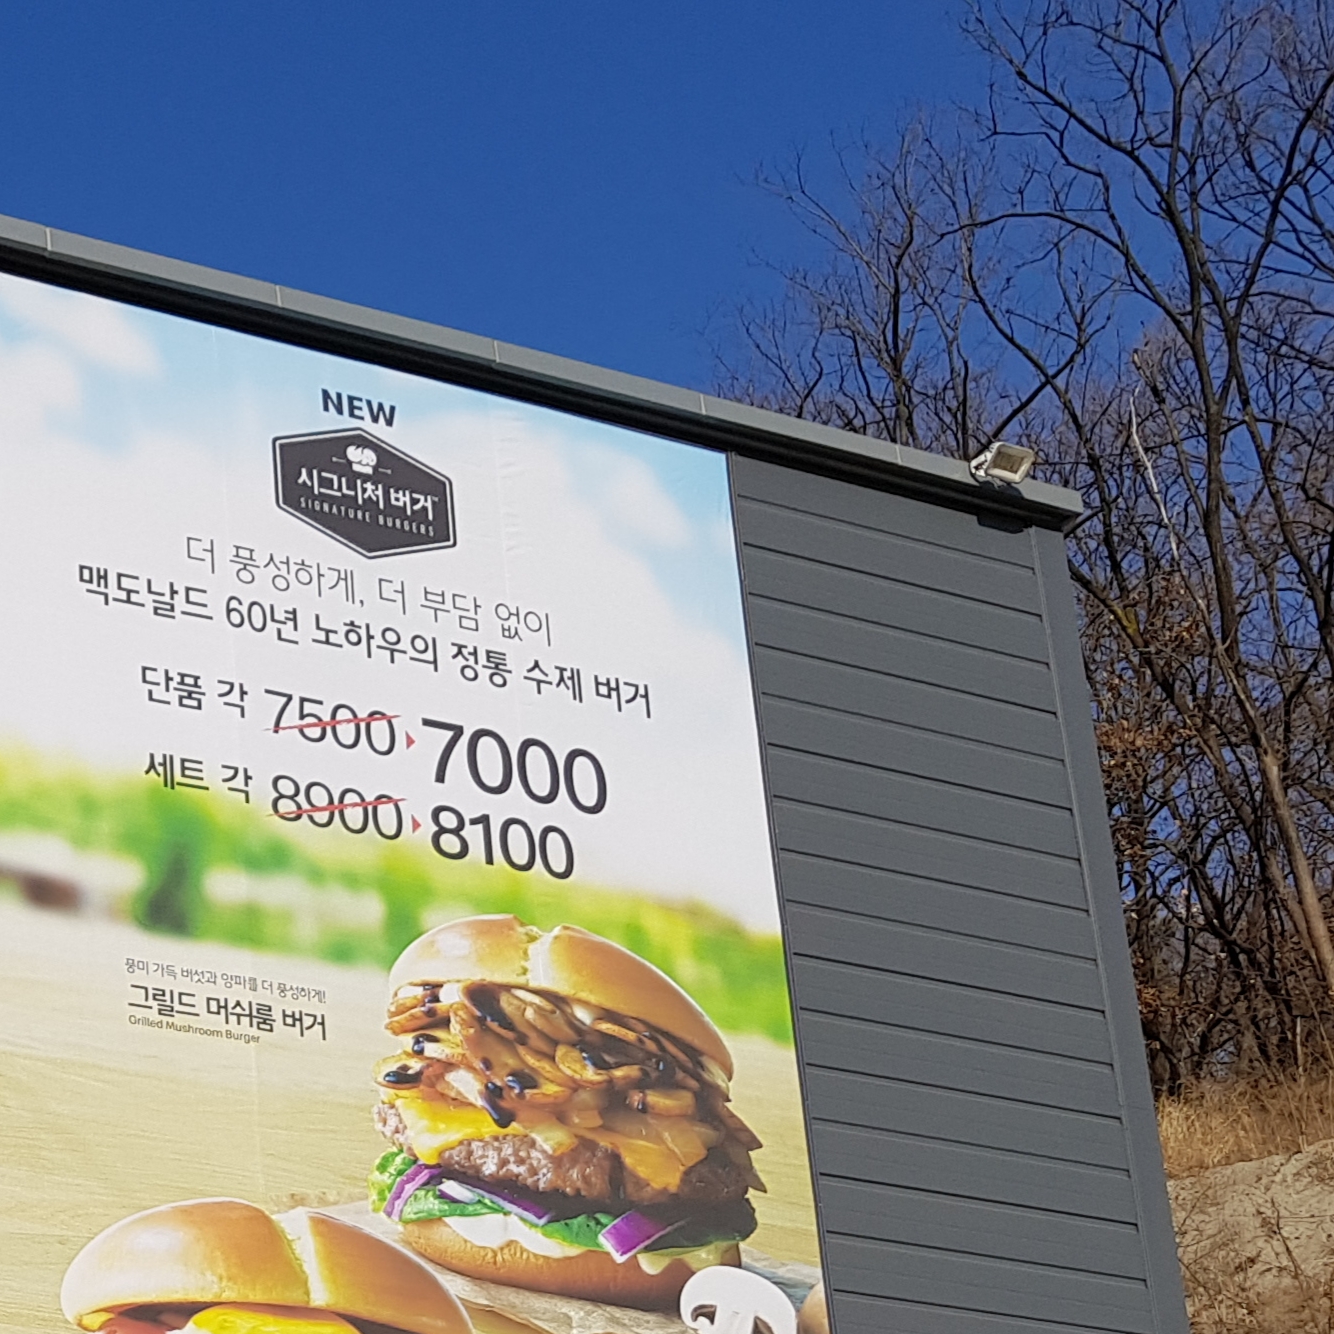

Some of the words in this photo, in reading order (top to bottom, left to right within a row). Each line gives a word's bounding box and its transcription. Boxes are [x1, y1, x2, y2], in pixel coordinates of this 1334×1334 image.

[321, 388, 396, 427] NEW
[297, 467, 384, 510] 시그니처
[300, 497, 371, 523] SIGNATURE
[378, 514, 435, 538] BURGERS
[186, 536, 216, 574] 더
[228, 545, 365, 608] 풍성하게,
[378, 578, 406, 616] 더
[419, 586, 481, 632] 부담
[494, 602, 552, 647] 없이
[77, 564, 214, 621] 맥도날드
[225, 596, 300, 645] 60년
[311, 612, 440, 673] 노하우의
[450, 642, 513, 690] 정통
[522, 658, 583, 703] 수제
[594, 674, 652, 719] 버거
[141, 665, 205, 711] 단품
[217, 680, 249, 719] 각
[264, 689, 399, 757] 7500
[421, 716, 608, 816] 7000
[144, 752, 210, 792] 세트
[221, 764, 254, 804] 각
[268, 775, 404, 841] 8900
[430, 804, 575, 880] 8100
[125, 957, 150, 976] 풍미
[152, 962, 178, 980] 가득
[181, 967, 217, 985] 버섯과
[221, 972, 258, 992] 양파를
[261, 979, 274, 994] 더
[128, 984, 200, 1018] 그릴드
[206, 996, 277, 1033] 머쉬룸
[282, 1009, 327, 1041] 버거
[128, 1015, 164, 1030] Grilled
[166, 1020, 223, 1039] Mushroom
[225, 1029, 261, 1044] Burger
